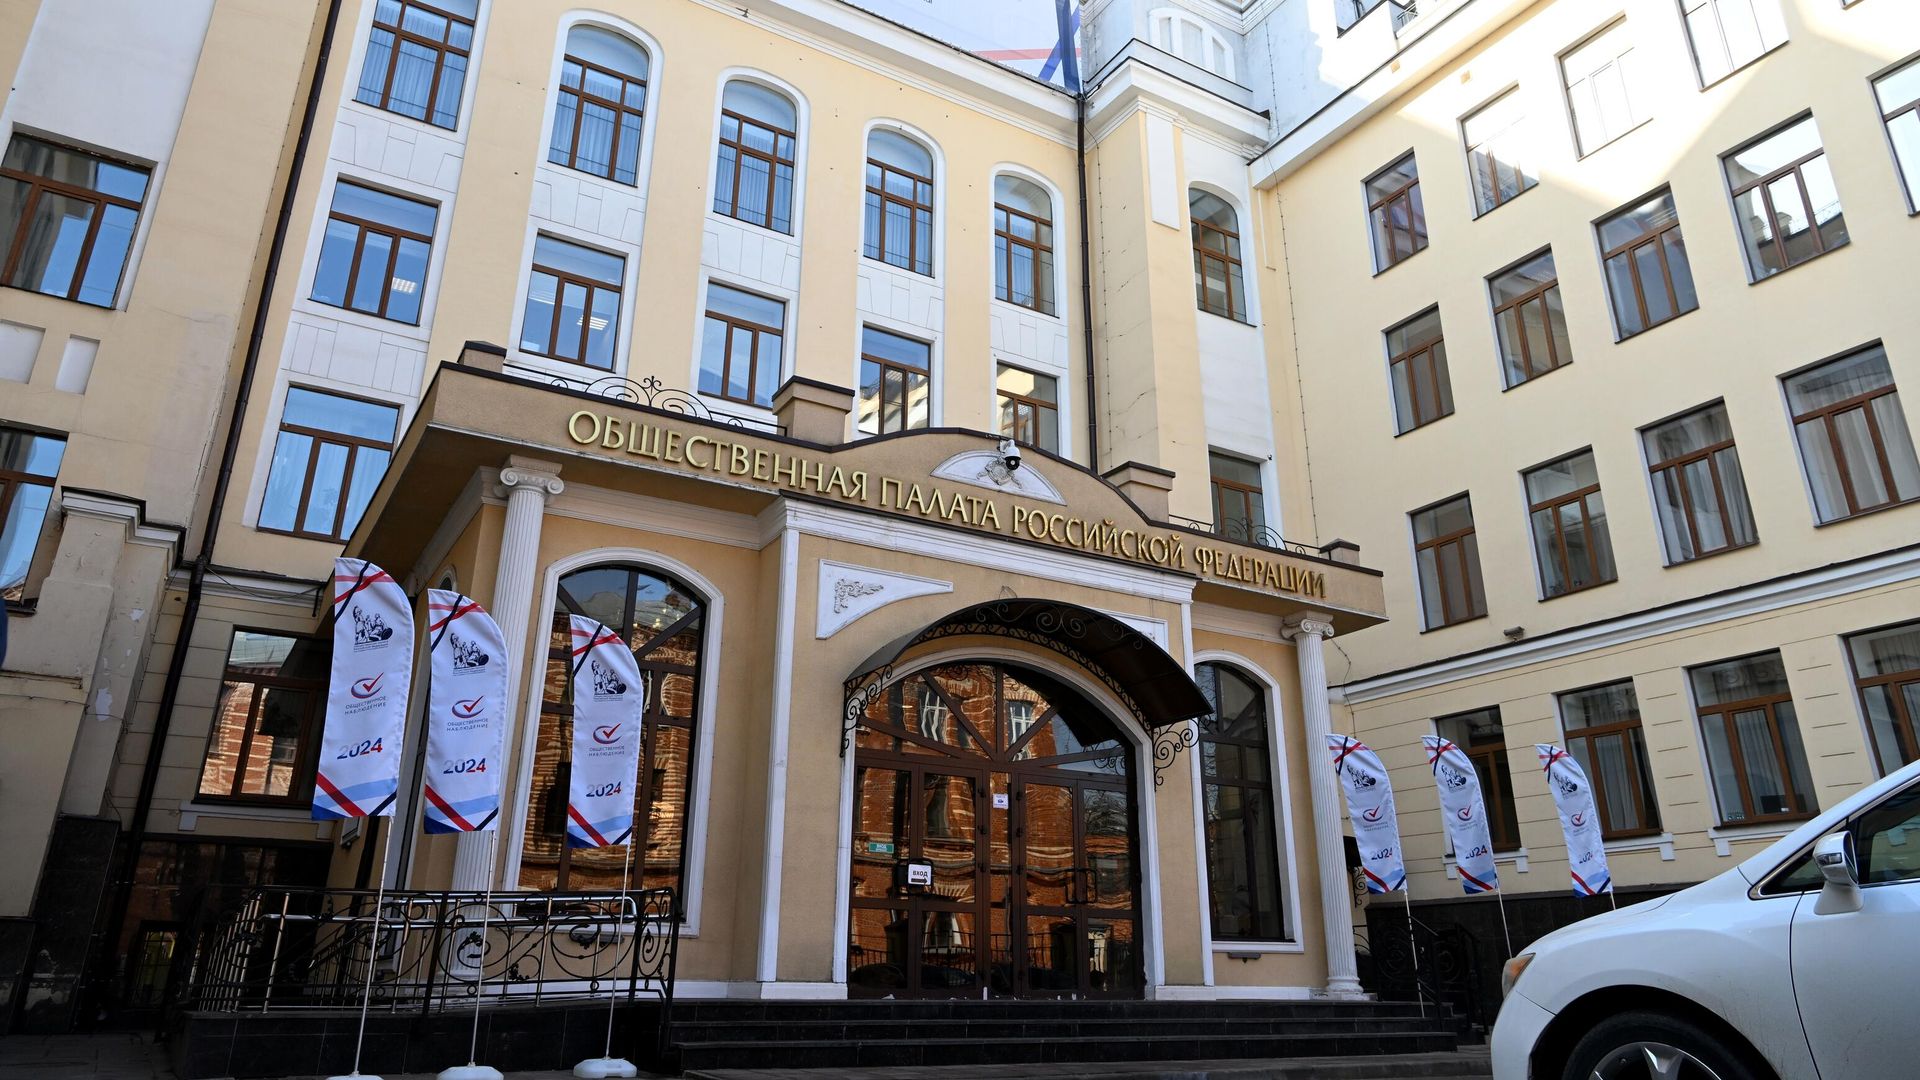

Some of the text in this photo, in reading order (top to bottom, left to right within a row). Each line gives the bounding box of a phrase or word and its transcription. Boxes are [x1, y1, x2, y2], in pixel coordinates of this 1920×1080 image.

[568, 410, 1326, 598] ОБЩЕСТВЕННАЯ ПАЛАТА РОССИЙСКОЙ ФЕДЕРАЦИИ
[344, 702, 387, 715] НАБЛЮДЕНИЕ
[345, 695, 387, 710] ОБЩЕСТВЕННОЕ
[446, 724, 489, 732] НАБЛЮДЕНИЕ
[337, 737, 383, 760] 2024
[443, 757, 487, 775] 2024
[585, 781, 622, 798] 2024
